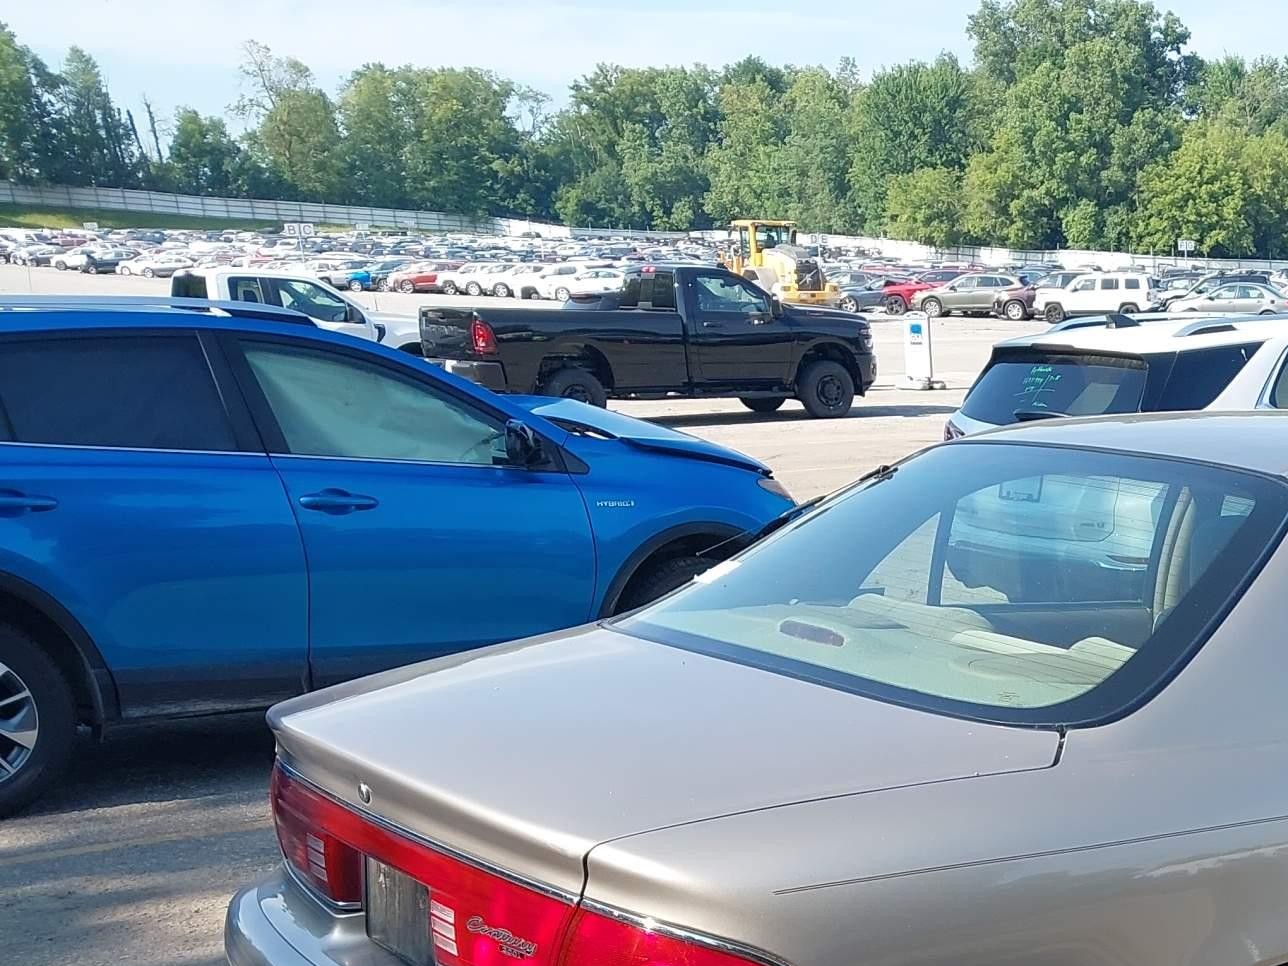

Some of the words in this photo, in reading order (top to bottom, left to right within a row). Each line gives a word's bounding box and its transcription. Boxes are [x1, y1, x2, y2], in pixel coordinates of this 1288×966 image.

[287, 225, 297, 236] B
[302, 224, 313, 236] C
[466, 915, 538, 957] Century
